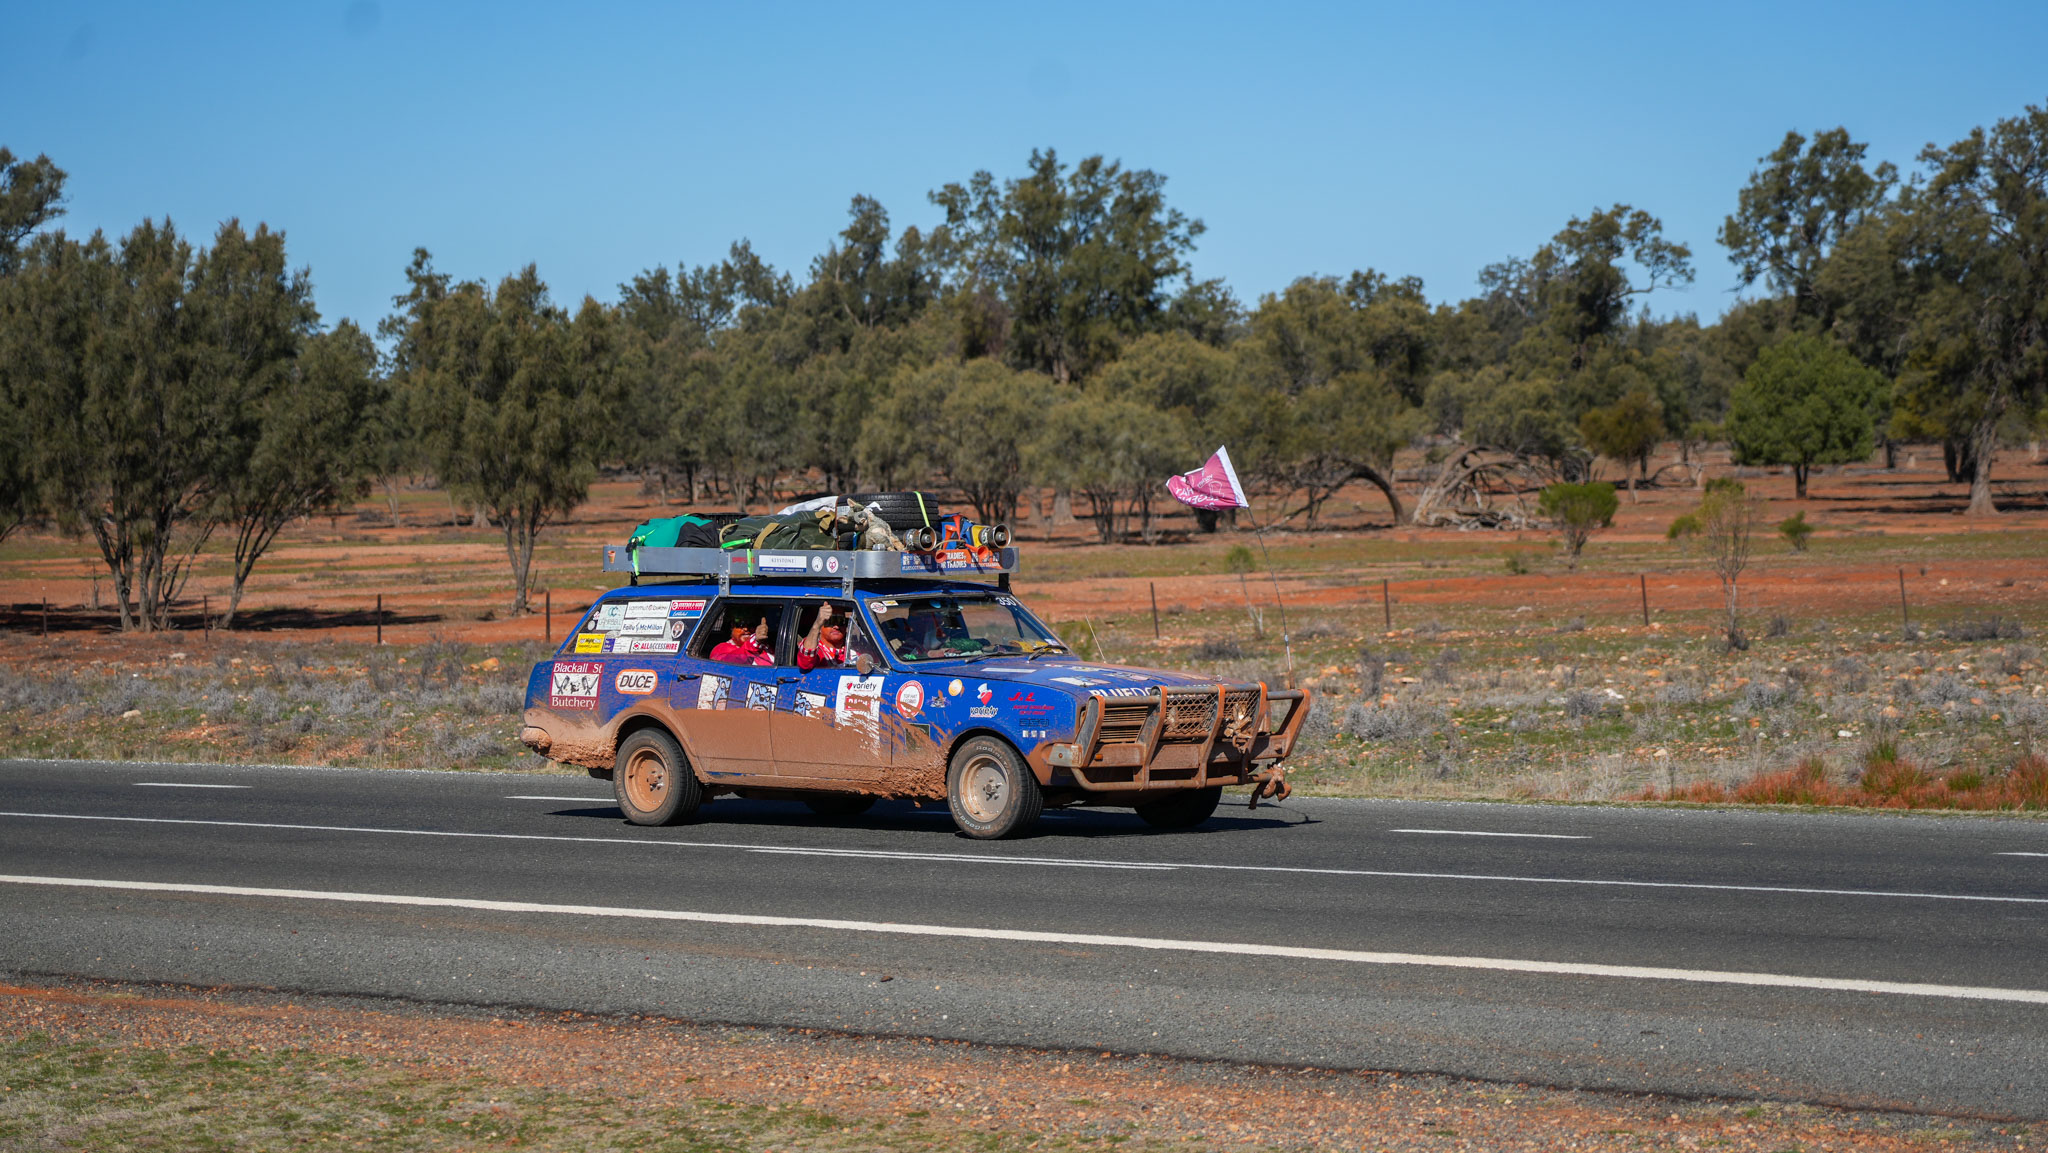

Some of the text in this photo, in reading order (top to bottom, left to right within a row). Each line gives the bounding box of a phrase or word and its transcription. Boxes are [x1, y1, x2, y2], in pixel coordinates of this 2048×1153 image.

[553, 663, 602, 673] Blackall St
[620, 675, 654, 688] DUCE
[853, 682, 877, 691] variety
[551, 697, 596, 710] Butchery
[970, 705, 998, 718] variety
